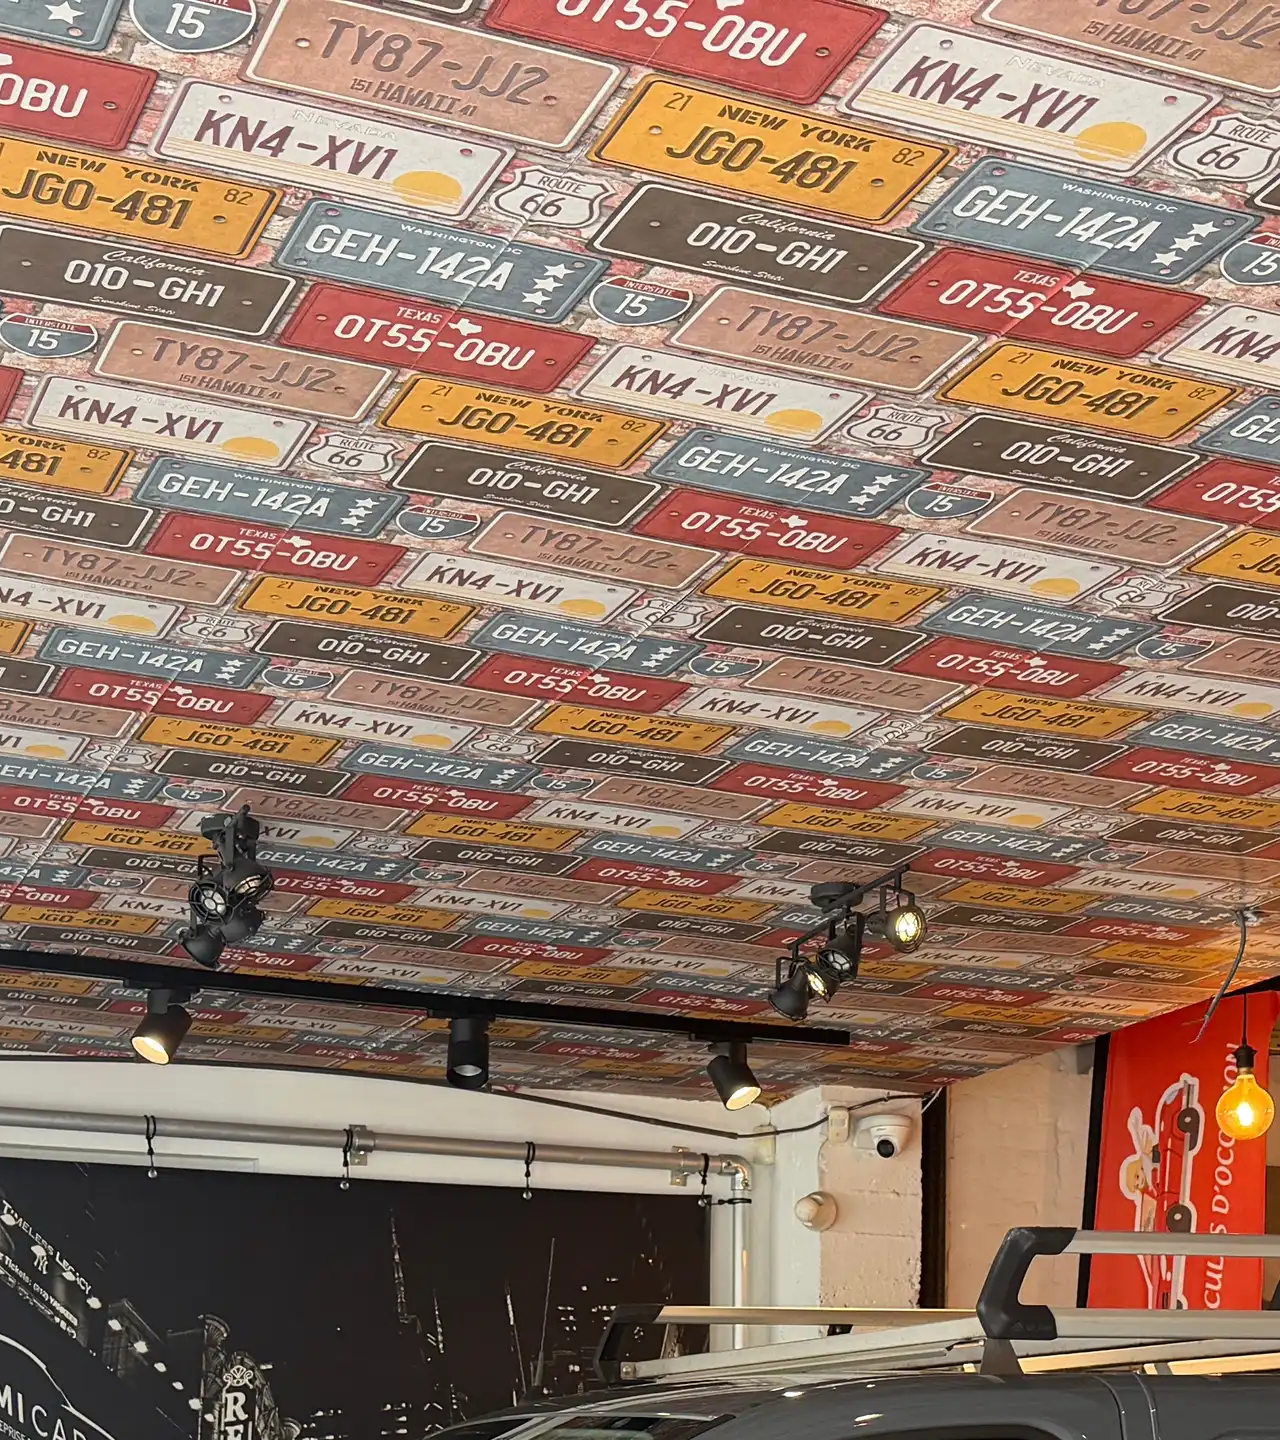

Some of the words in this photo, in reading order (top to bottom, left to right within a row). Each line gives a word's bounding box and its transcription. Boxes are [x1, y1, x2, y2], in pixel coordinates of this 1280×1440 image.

[323, 18, 550, 106] TY87-JJ2
[663, 91, 694, 111] 21
[717, 104, 788, 131] NEW
[800, 123, 877, 153] YORK
[35, 146, 106, 172] NEW
[121, 165, 201, 194] YORK
[892, 147, 926, 168] 82
[224, 188, 254, 208] 82
[536, 175, 585, 194] ROUTE
[518, 193, 565, 218] 66
[1062, 182, 1152, 210] WASHINGTON
[1154, 206, 1177, 216] DC
[735, 212, 835, 241] California
[954, 183, 1159, 254] GEH-142A
[103, 249, 206, 277] California
[305, 223, 512, 291] GEH-142A
[623, 279, 675, 296] INTERSTATE
[1011, 267, 1059, 286] TEXAS
[395, 305, 442, 324] TEXAS
[614, 292, 655, 317] 15
[1050, 357, 1109, 376] NEW
[1115, 369, 1179, 391] YORK
[678, 446, 848, 495] GEH-142A
[56, 639, 203, 673] GEH-142A
